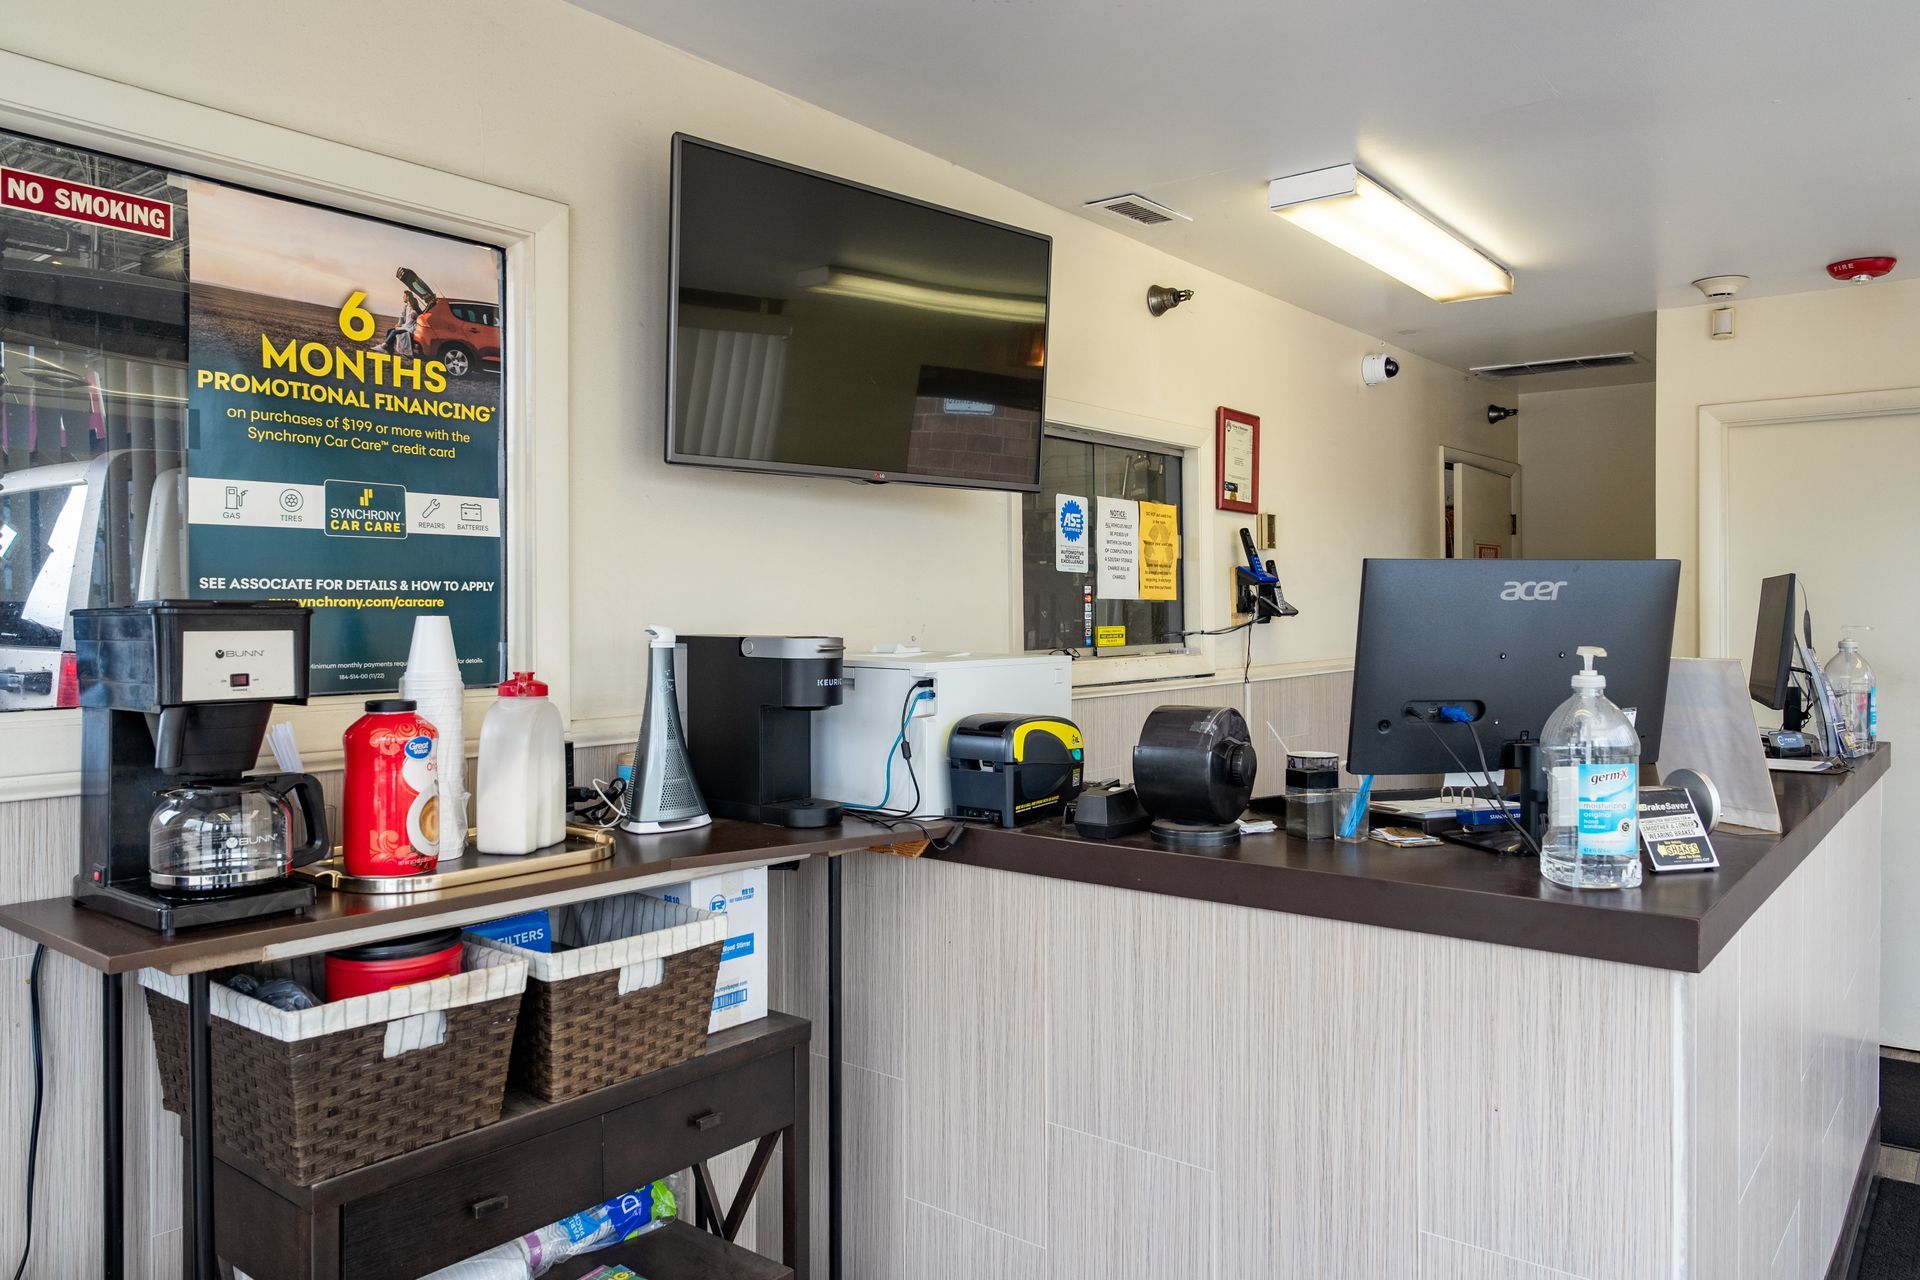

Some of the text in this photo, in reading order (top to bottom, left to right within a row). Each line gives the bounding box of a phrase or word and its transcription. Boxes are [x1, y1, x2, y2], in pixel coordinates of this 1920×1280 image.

[8, 177, 165, 229] NO SMOKING
[1834, 263, 1855, 272] FIRE
[339, 291, 376, 342] 6
[262, 333, 447, 393] MONTHS
[197, 369, 370, 409] PROMOTIONAL
[227, 408, 471, 443] on purchases of $199 or more with the
[247, 426, 321, 448] Synchrony
[324, 434, 349, 448] Car
[392, 443, 426, 456] credit
[429, 447, 456, 458] card
[222, 511, 241, 520] GAS
[280, 514, 303, 522] TIRES
[330, 508, 401, 522] SYNCHRONY
[1110, 510, 1127, 518] NOTICE:
[330, 520, 360, 531] CAR
[418, 521, 446, 530] REPAIRS
[1063, 513, 1082, 528] ASE
[457, 524, 489, 532] BATTERIES
[1061, 549, 1084, 557] AUTOMOTIVE
[199, 577, 495, 592] SEE ASSOCIATE FOR DETAILS & HOW TO APPLY
[1500, 580, 1568, 601] acer
[268, 596, 445, 610] ynchrony.com/carcare
[225, 650, 264, 658] BUNN
[338, 661, 362, 669] monthly
[363, 661, 393, 669] payments
[408, 741, 429, 750] Great
[1583, 802, 1627, 811] moisturizing
[1583, 811, 1611, 819] original
[1643, 823, 1669, 832] SMOOTHER
[1676, 821, 1695, 829] LONGER
[1648, 829, 1696, 840] WEARING BRAKES
[1666, 843, 1699, 856] SHAKES
